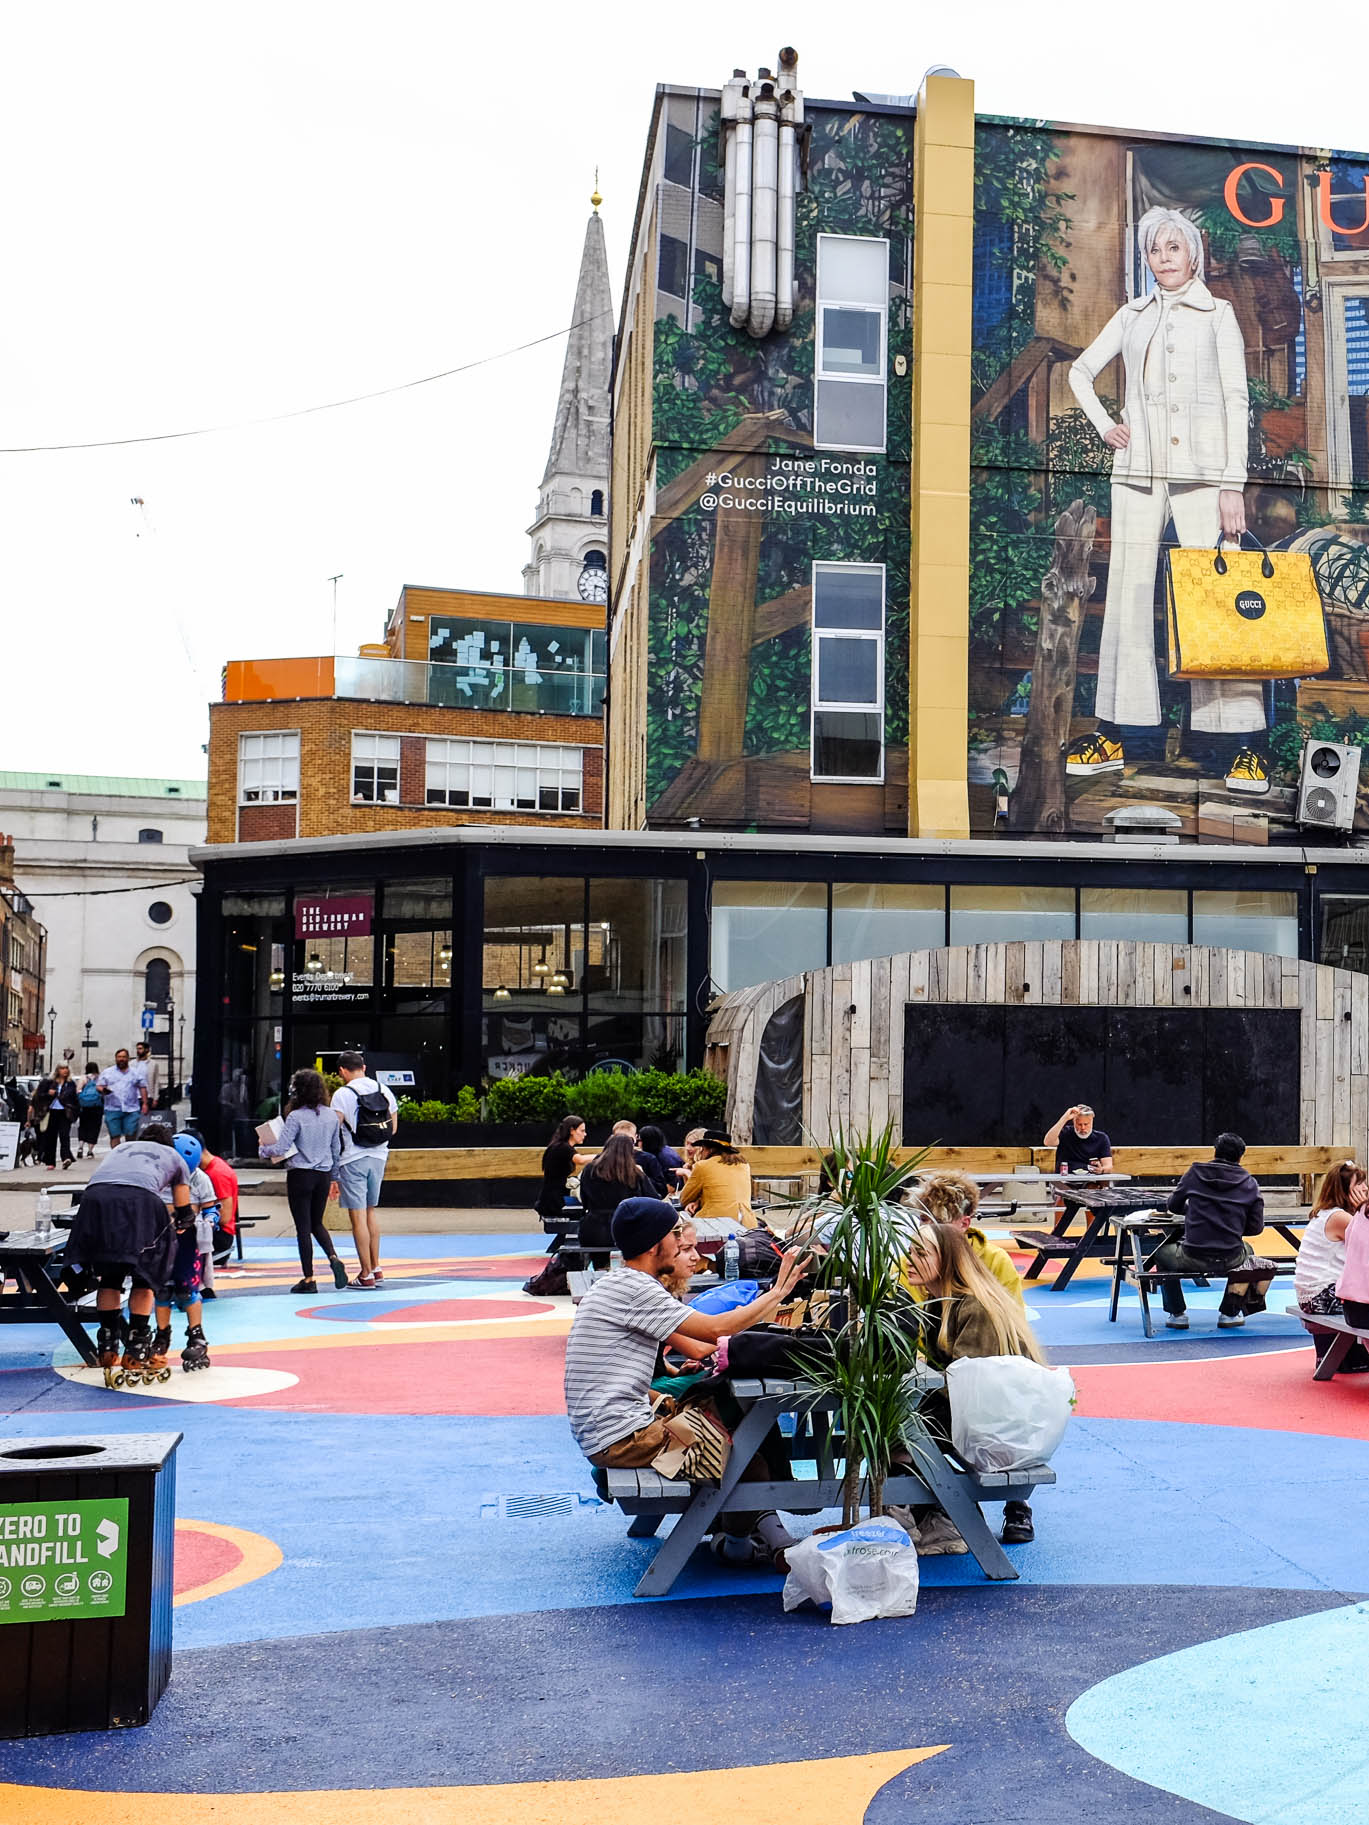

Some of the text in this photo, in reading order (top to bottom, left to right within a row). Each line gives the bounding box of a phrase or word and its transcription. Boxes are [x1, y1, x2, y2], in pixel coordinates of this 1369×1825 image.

[771, 457, 877, 476] Jane Fonda
[705, 471, 877, 496] #GucciOffTheGrid
[700, 492, 877, 516] @GucciEquilibrium
[1239, 599, 1262, 610] GUCCI
[302, 907, 321, 915] THE
[302, 912, 364, 924] OLD TRUMAN
[302, 922, 349, 932] BREWERY
[292, 972, 314, 982] Events
[54, 1513, 81, 1537] TO
